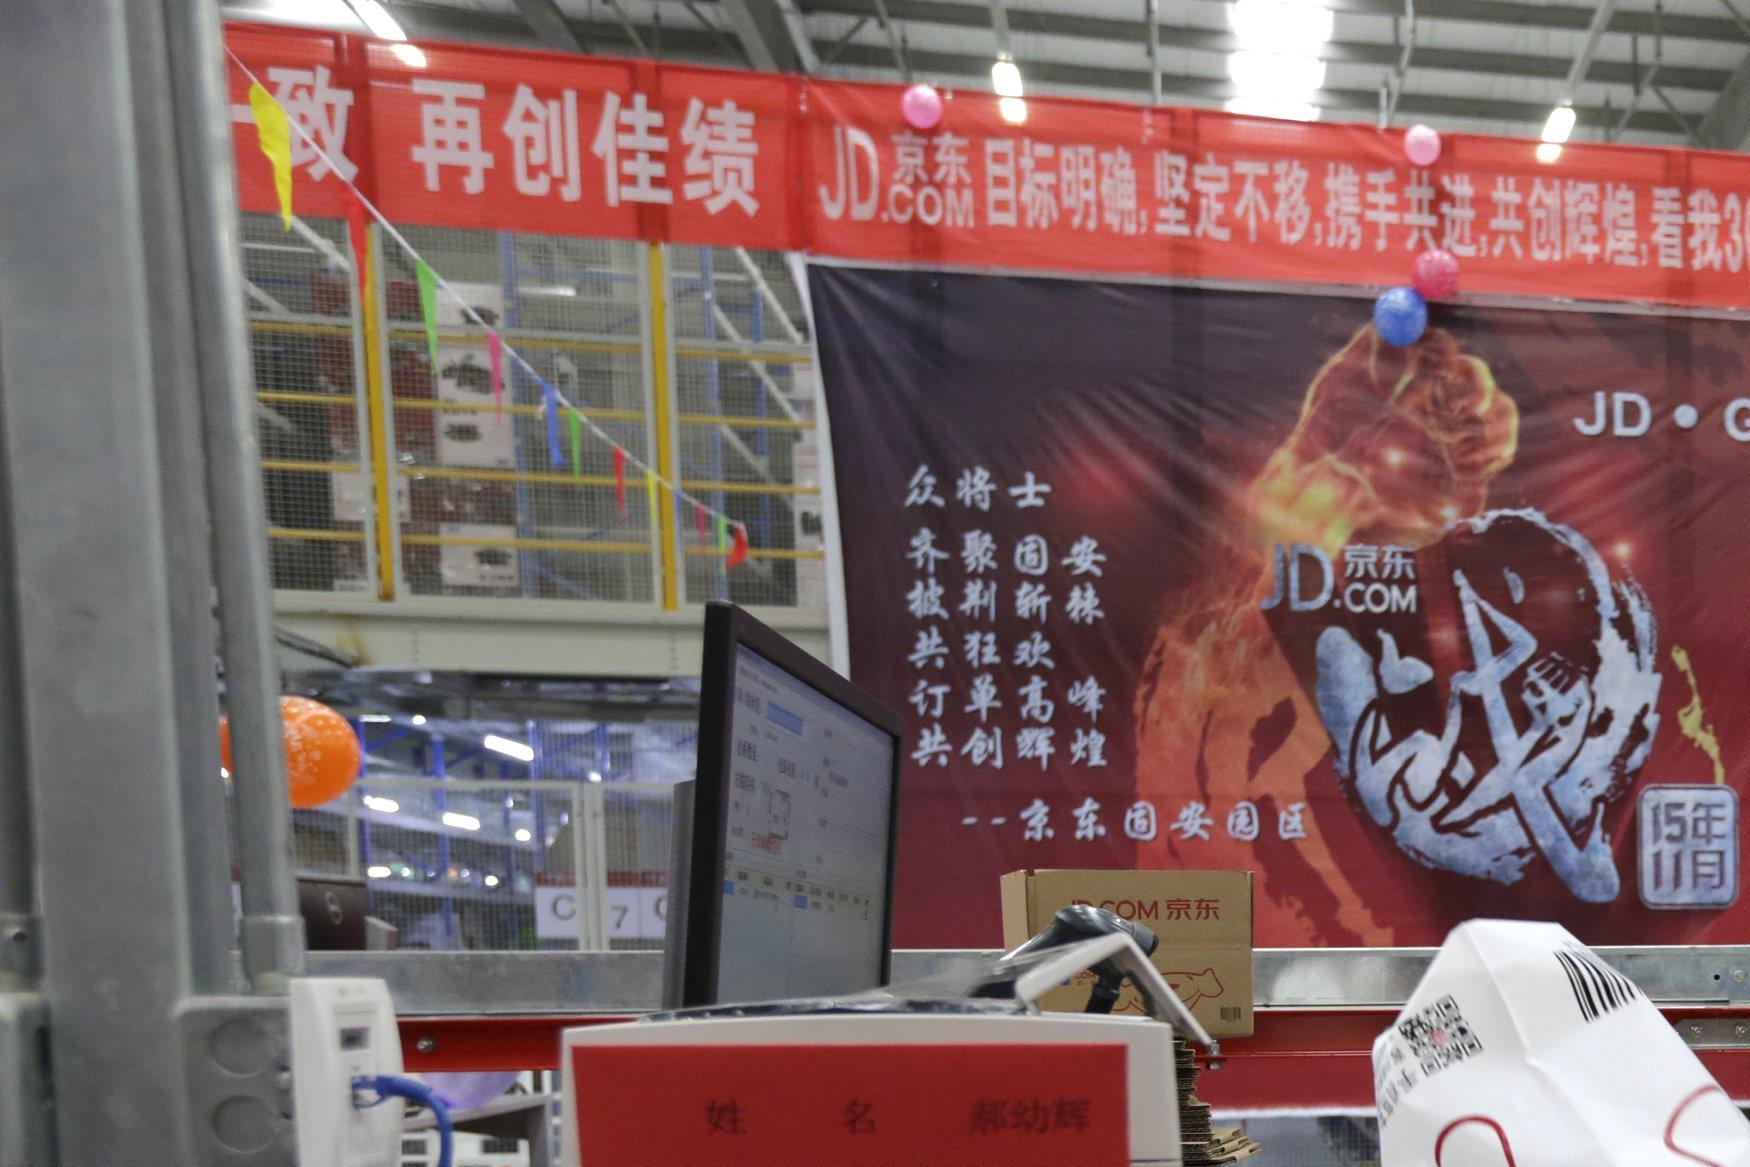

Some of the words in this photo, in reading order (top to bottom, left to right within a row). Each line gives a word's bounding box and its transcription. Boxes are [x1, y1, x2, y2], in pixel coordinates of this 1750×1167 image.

[411, 78, 758, 216] 再创佳绩
[891, 131, 971, 185] 京东
[1574, 392, 1651, 436] JD
[905, 464, 1051, 511] 众将士
[905, 528, 1107, 576] 齐聚固安
[1343, 544, 1415, 579] 京东
[907, 627, 1054, 669] 共狂欢
[909, 674, 1106, 723] 订单高峰
[912, 723, 1107, 770] 共创辉煌
[1651, 802, 1728, 846] 15年
[1651, 850, 1726, 893] 11月
[1166, 899, 1220, 920] 京东
